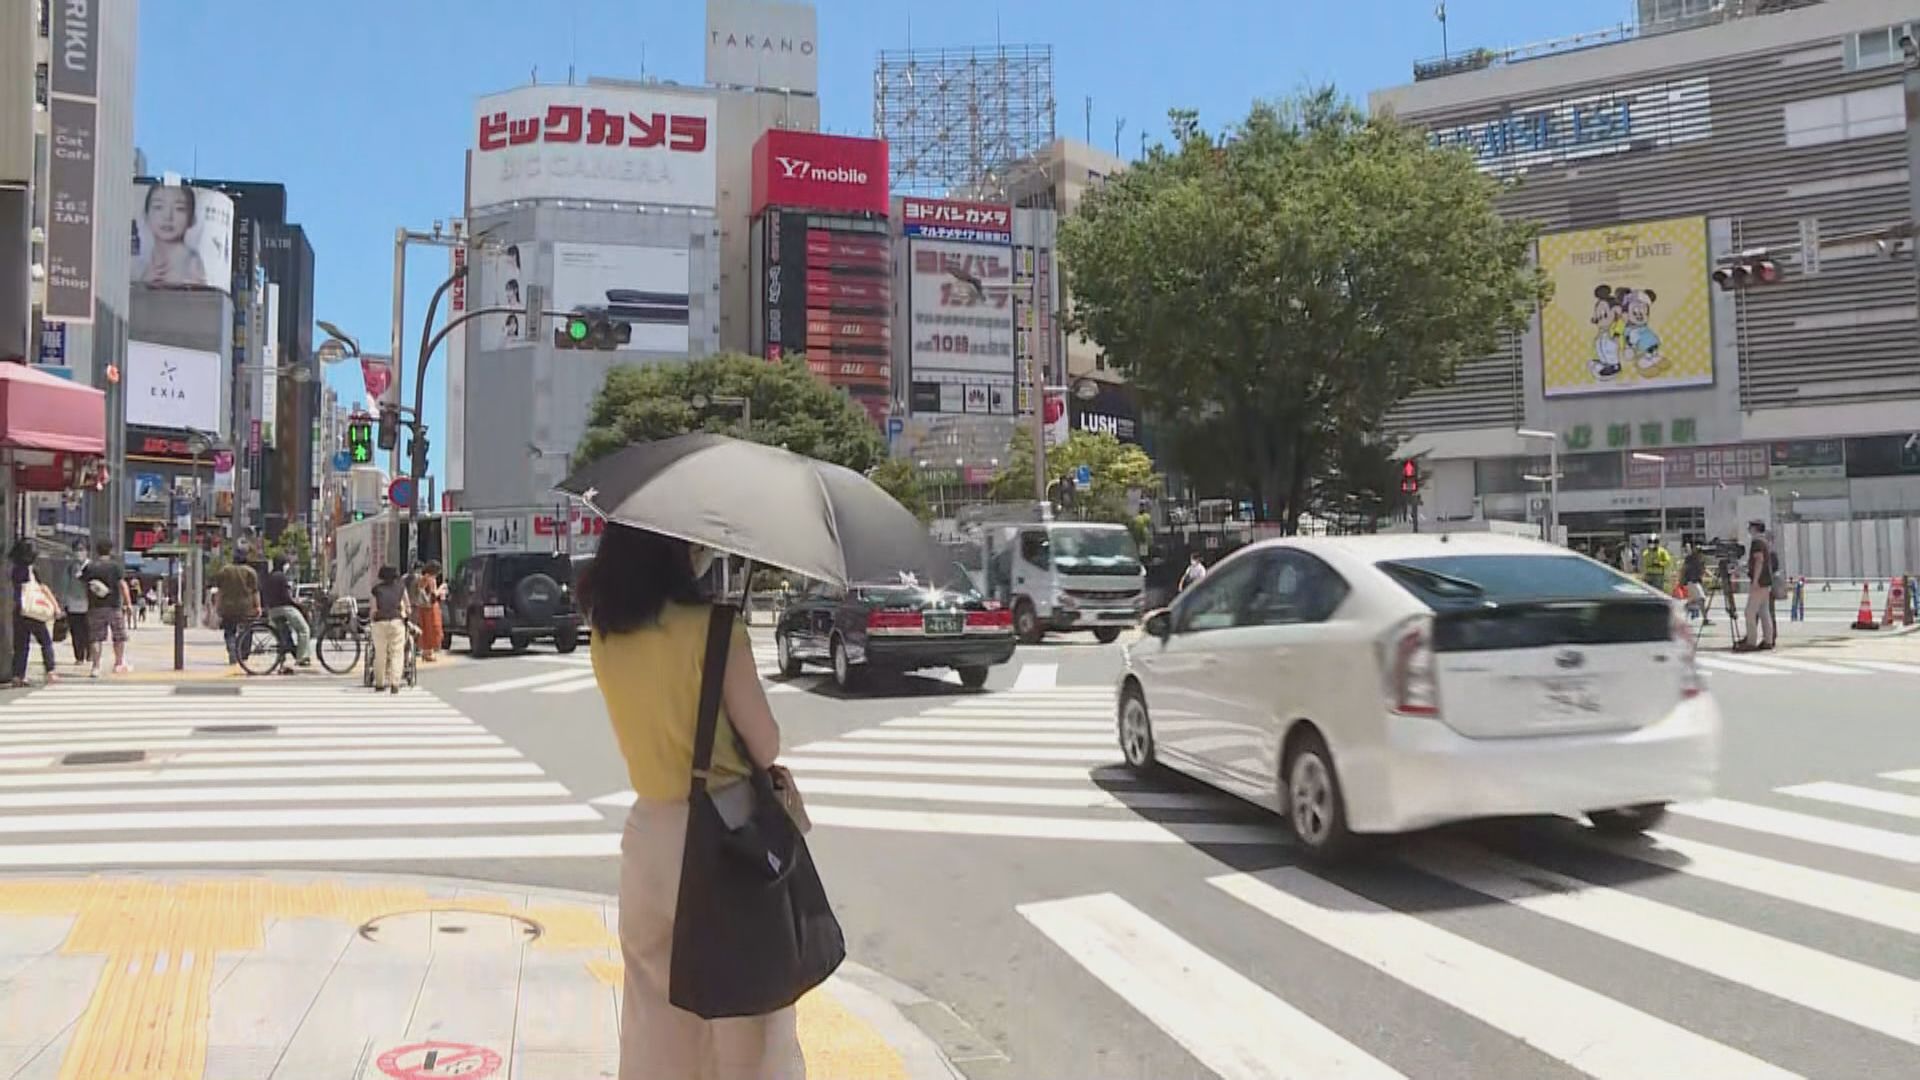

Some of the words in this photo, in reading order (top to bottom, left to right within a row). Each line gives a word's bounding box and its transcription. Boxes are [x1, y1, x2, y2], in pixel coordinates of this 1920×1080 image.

[711, 31, 814, 55] TAKANO
[479, 104, 708, 152] ビックカメラ
[905, 202, 1008, 226] ヨドバシカメラ
[1571, 246, 1634, 266] PERFECT
[1635, 242, 1673, 258] DATE
[150, 386, 186, 399] EXIA
[1080, 412, 1118, 436] LUSH
